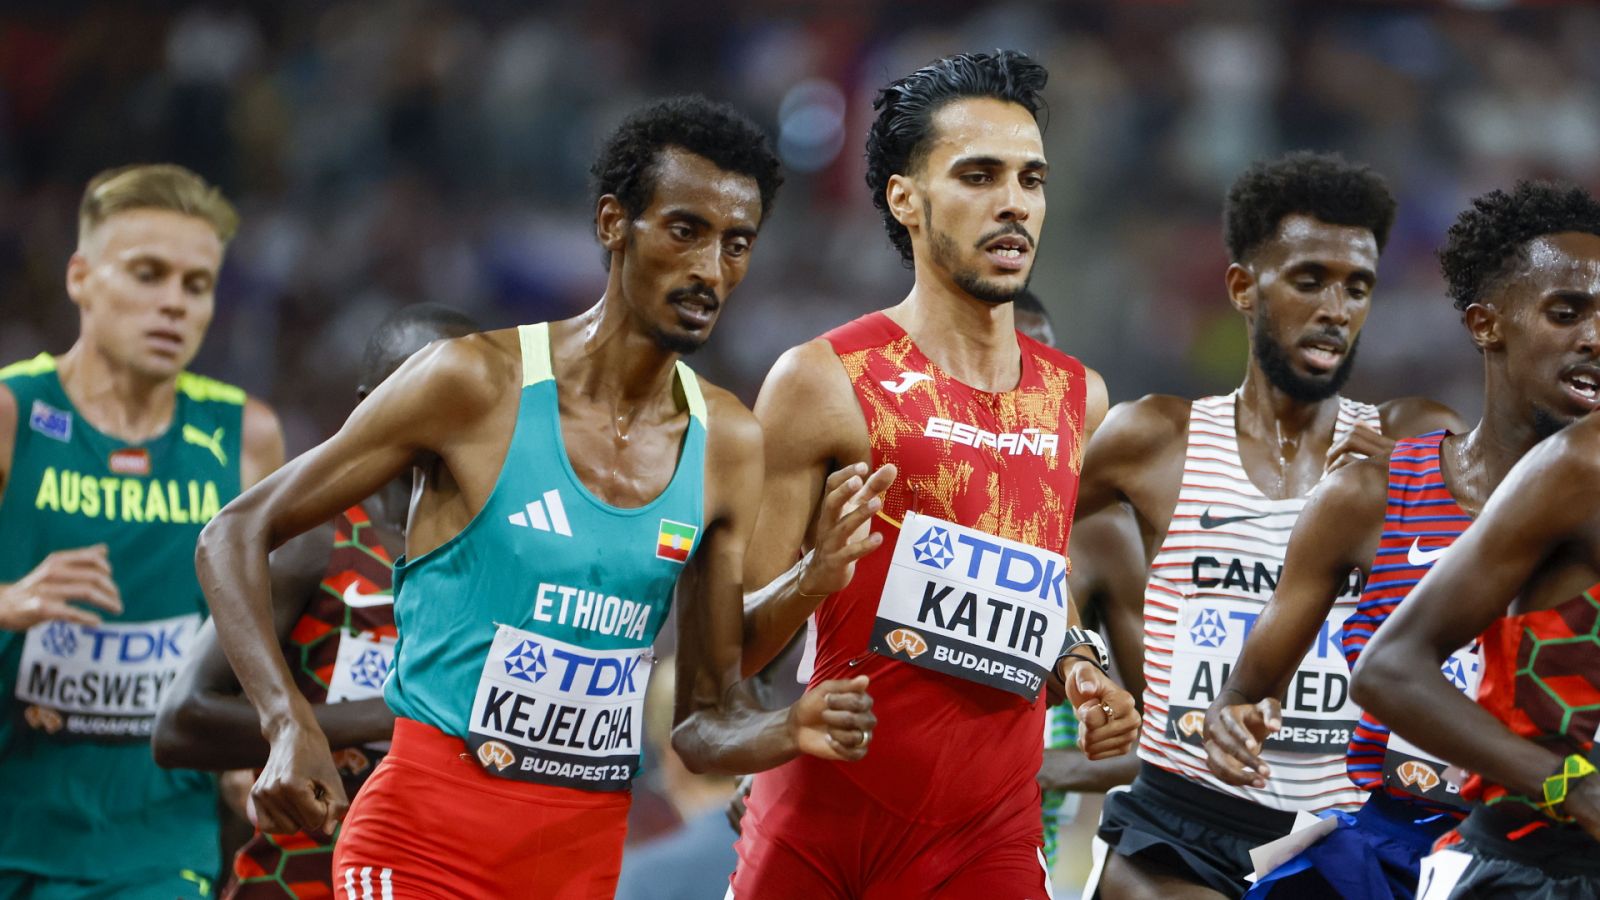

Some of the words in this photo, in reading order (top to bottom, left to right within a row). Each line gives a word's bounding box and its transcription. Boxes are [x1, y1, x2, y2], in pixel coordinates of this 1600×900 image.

[924, 416, 1059, 457] ESPAÑA
[35, 466, 221, 524] AUSTRALIA
[957, 533, 1067, 609] TDK
[533, 582, 651, 641] ETHIOPIA
[917, 581, 1049, 658] KATIR
[1229, 611, 1346, 659] TK
[81, 625, 184, 663] TDK
[28, 661, 176, 707] McSWEY
[552, 648, 641, 697] TDK
[1188, 661, 1348, 713] AED
[481, 686, 633, 751] KEJELCHA
